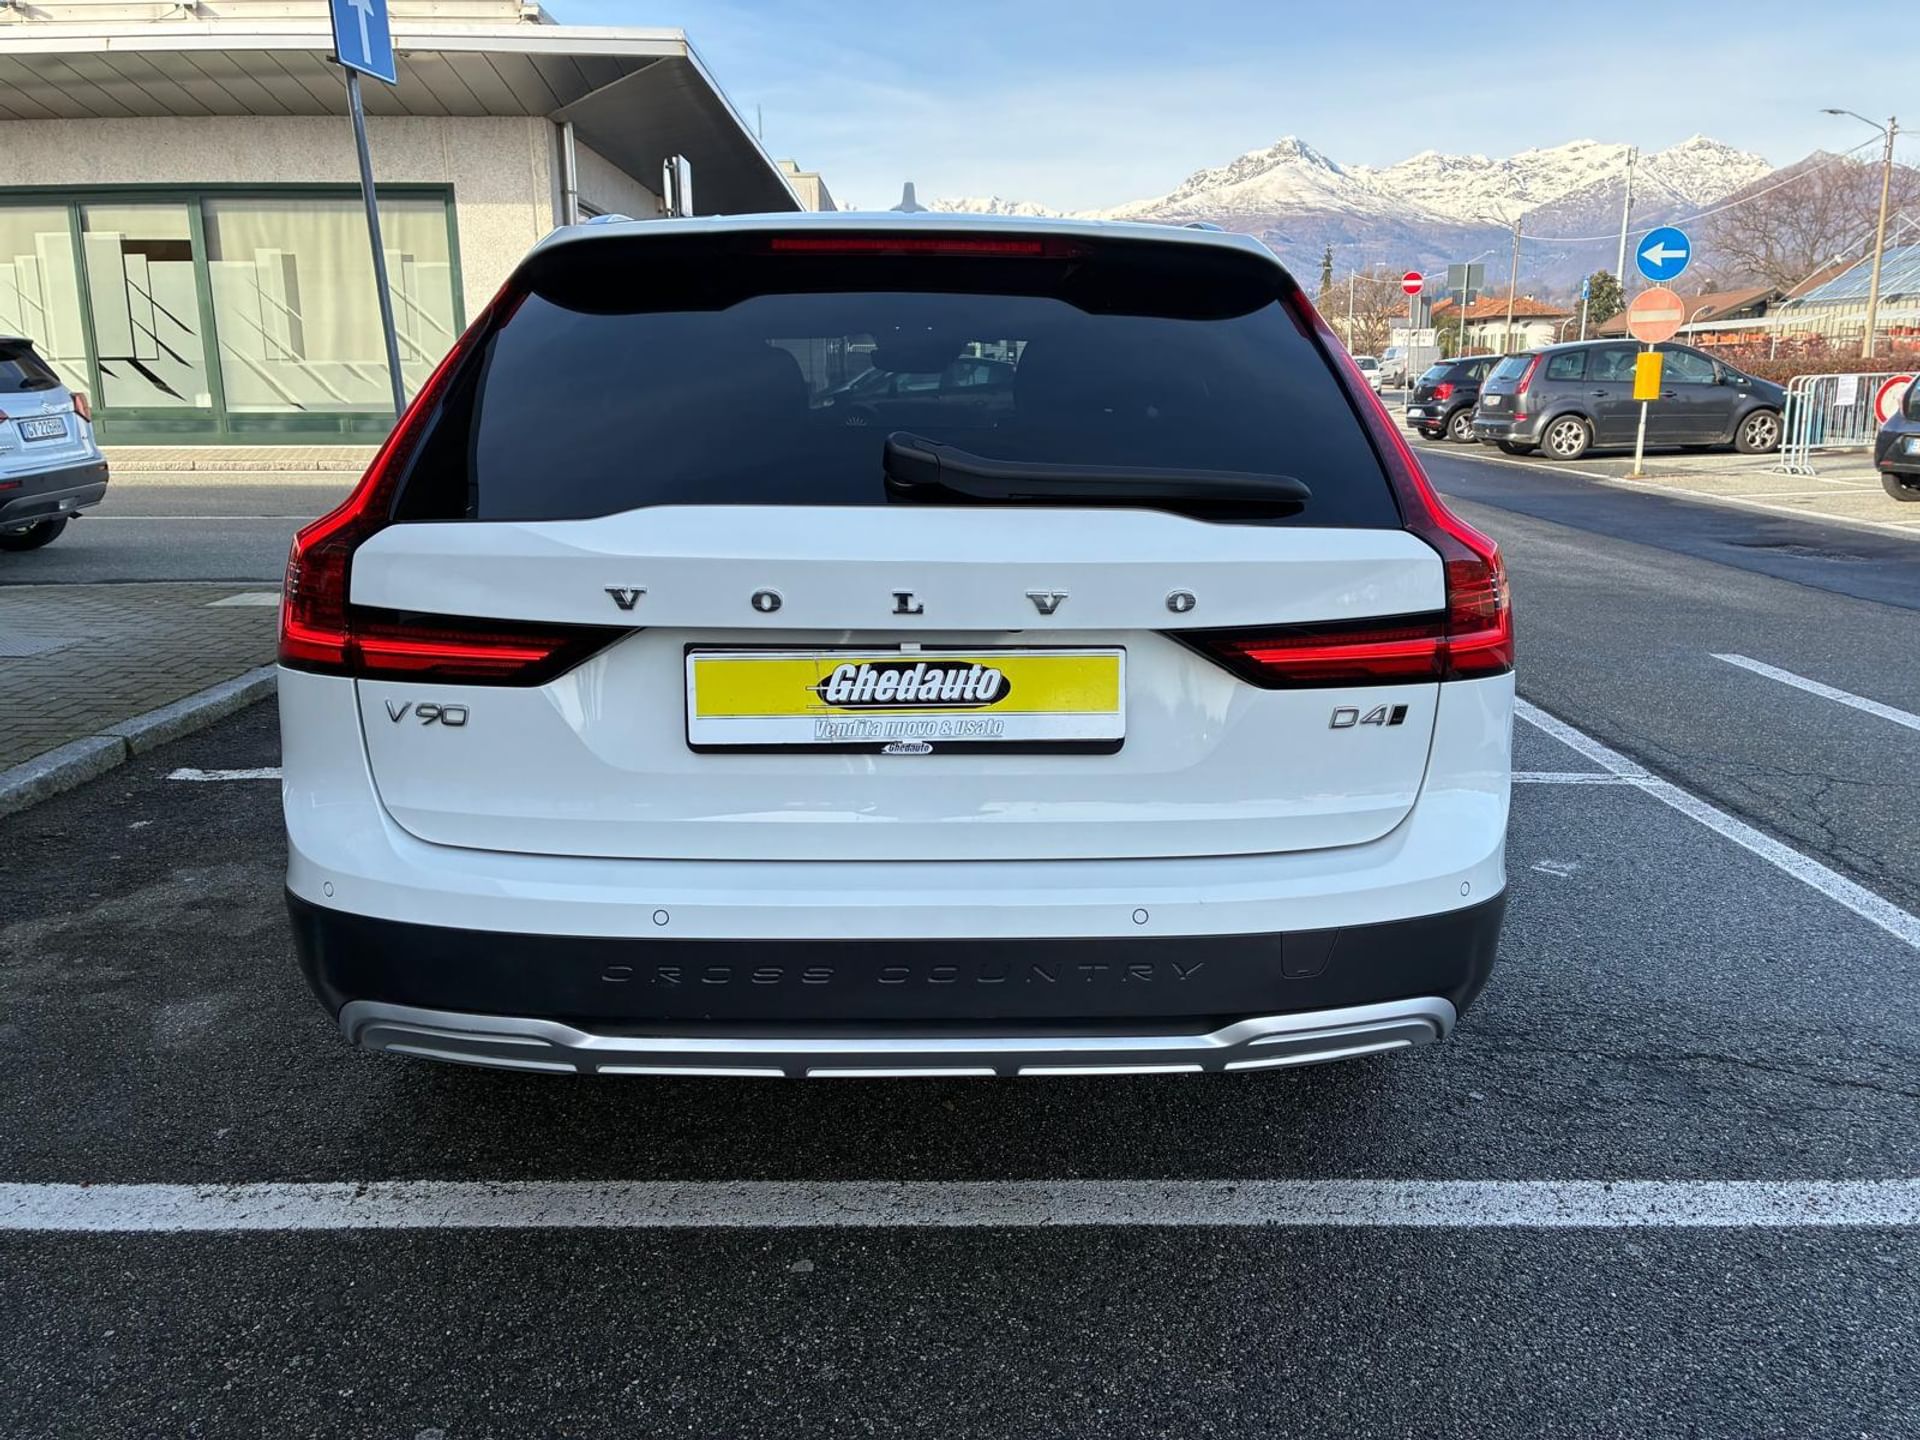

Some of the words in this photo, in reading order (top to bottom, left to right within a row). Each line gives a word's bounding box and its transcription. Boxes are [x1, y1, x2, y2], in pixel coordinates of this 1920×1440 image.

[604, 584, 1197, 616] VOLVO
[826, 663, 1002, 702] Ghedauto
[385, 699, 470, 727] V90
[1328, 703, 1388, 729] D4
[814, 719, 882, 738] Vendita
[883, 719, 937, 737] nuovo
[939, 718, 954, 736] &
[954, 717, 1005, 736] usato
[887, 741, 931, 753] Ghedauto
[601, 965, 835, 984] CROSS
[877, 962, 1205, 984] COUNTRY
